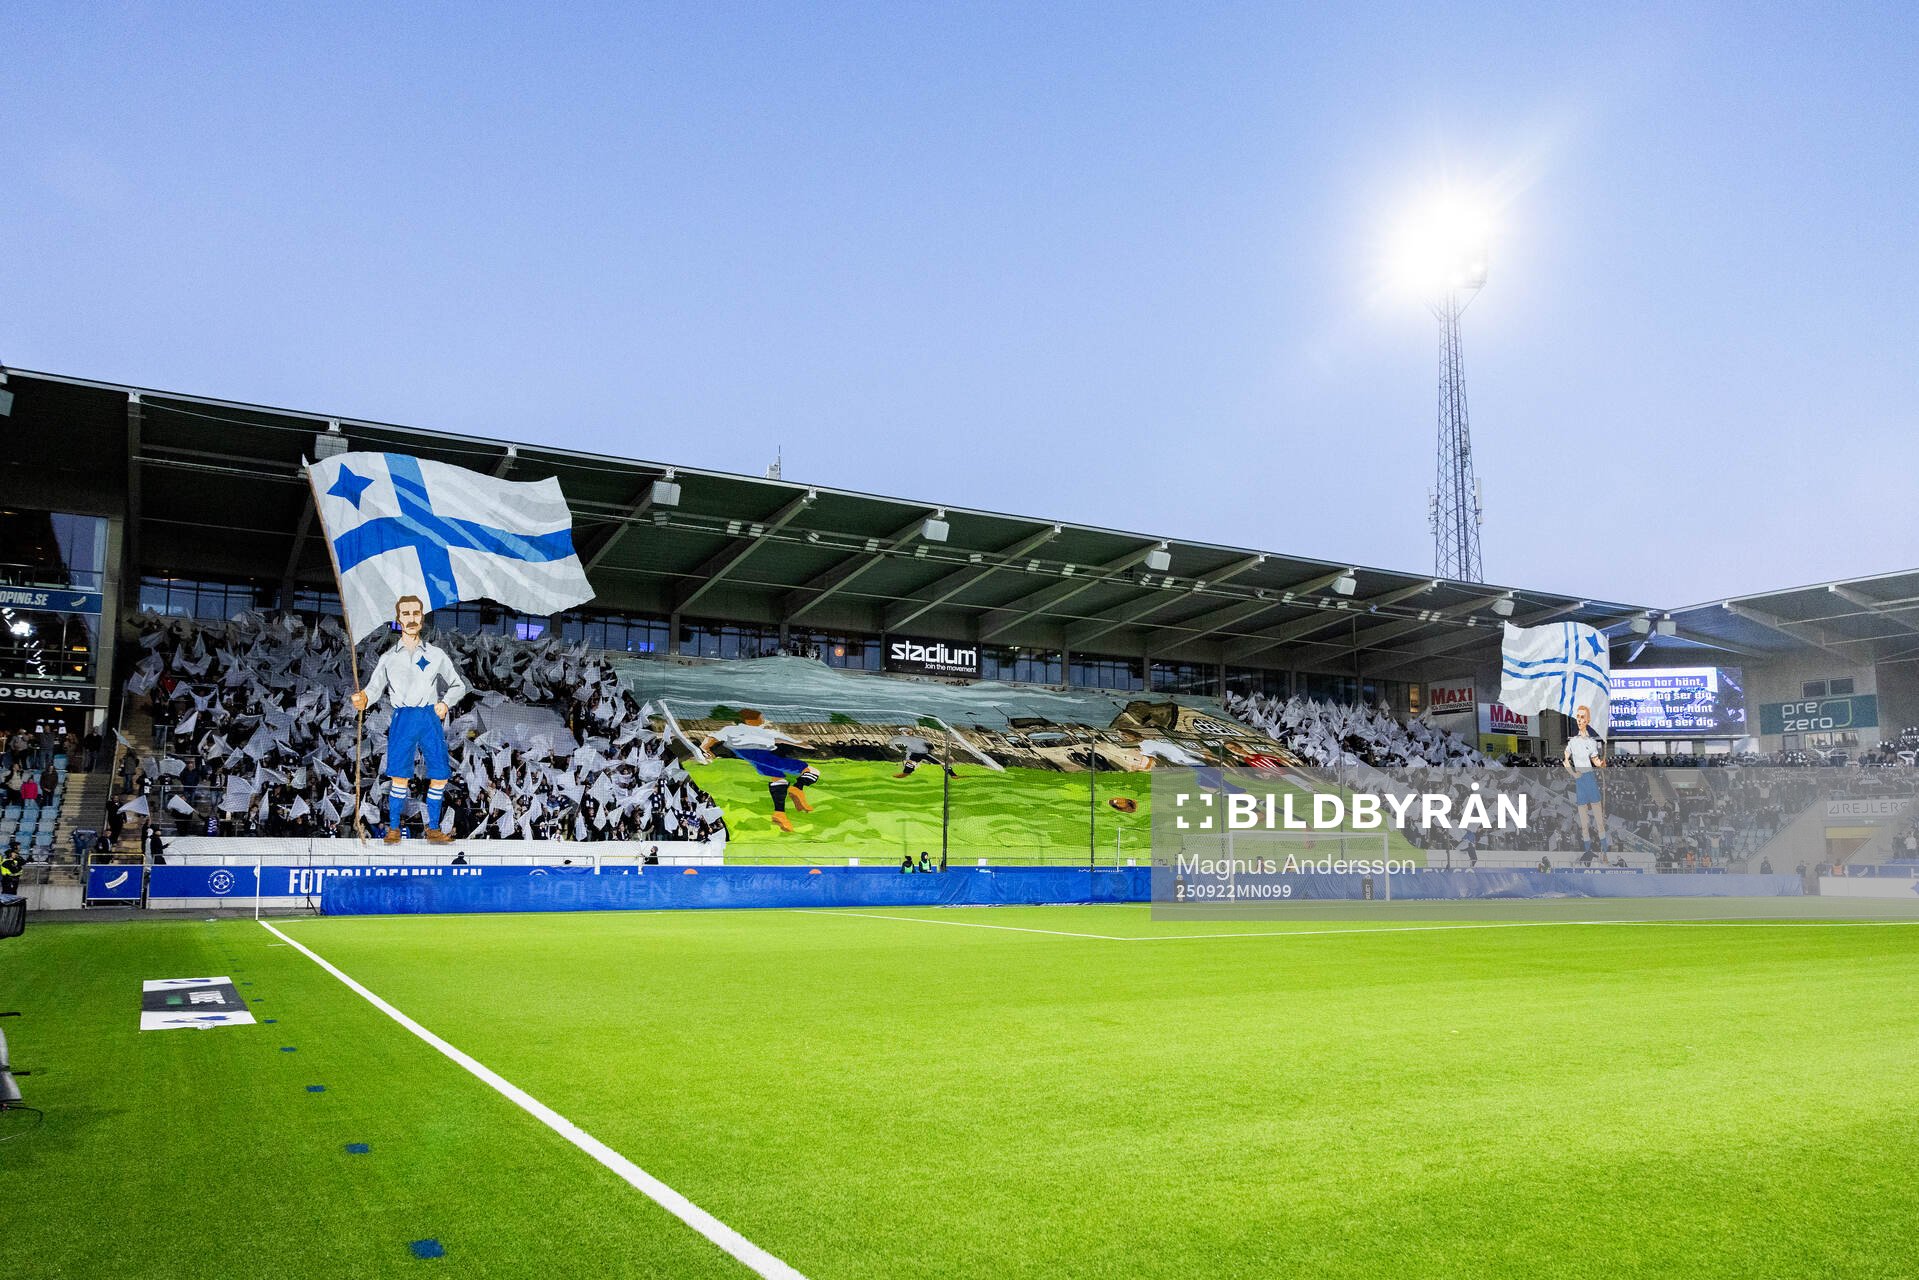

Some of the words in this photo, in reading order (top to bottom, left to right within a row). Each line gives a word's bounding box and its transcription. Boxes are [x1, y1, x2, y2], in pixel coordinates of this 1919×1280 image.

[891, 640, 977, 667] stadium
[14, 688, 81, 700] SUGAR
[1431, 687, 1473, 706] MAXI
[1490, 705, 1528, 724] MAXI
[1782, 701, 1818, 719] pre
[1675, 718, 1693, 727] ser
[1783, 717, 1833, 732] zero
